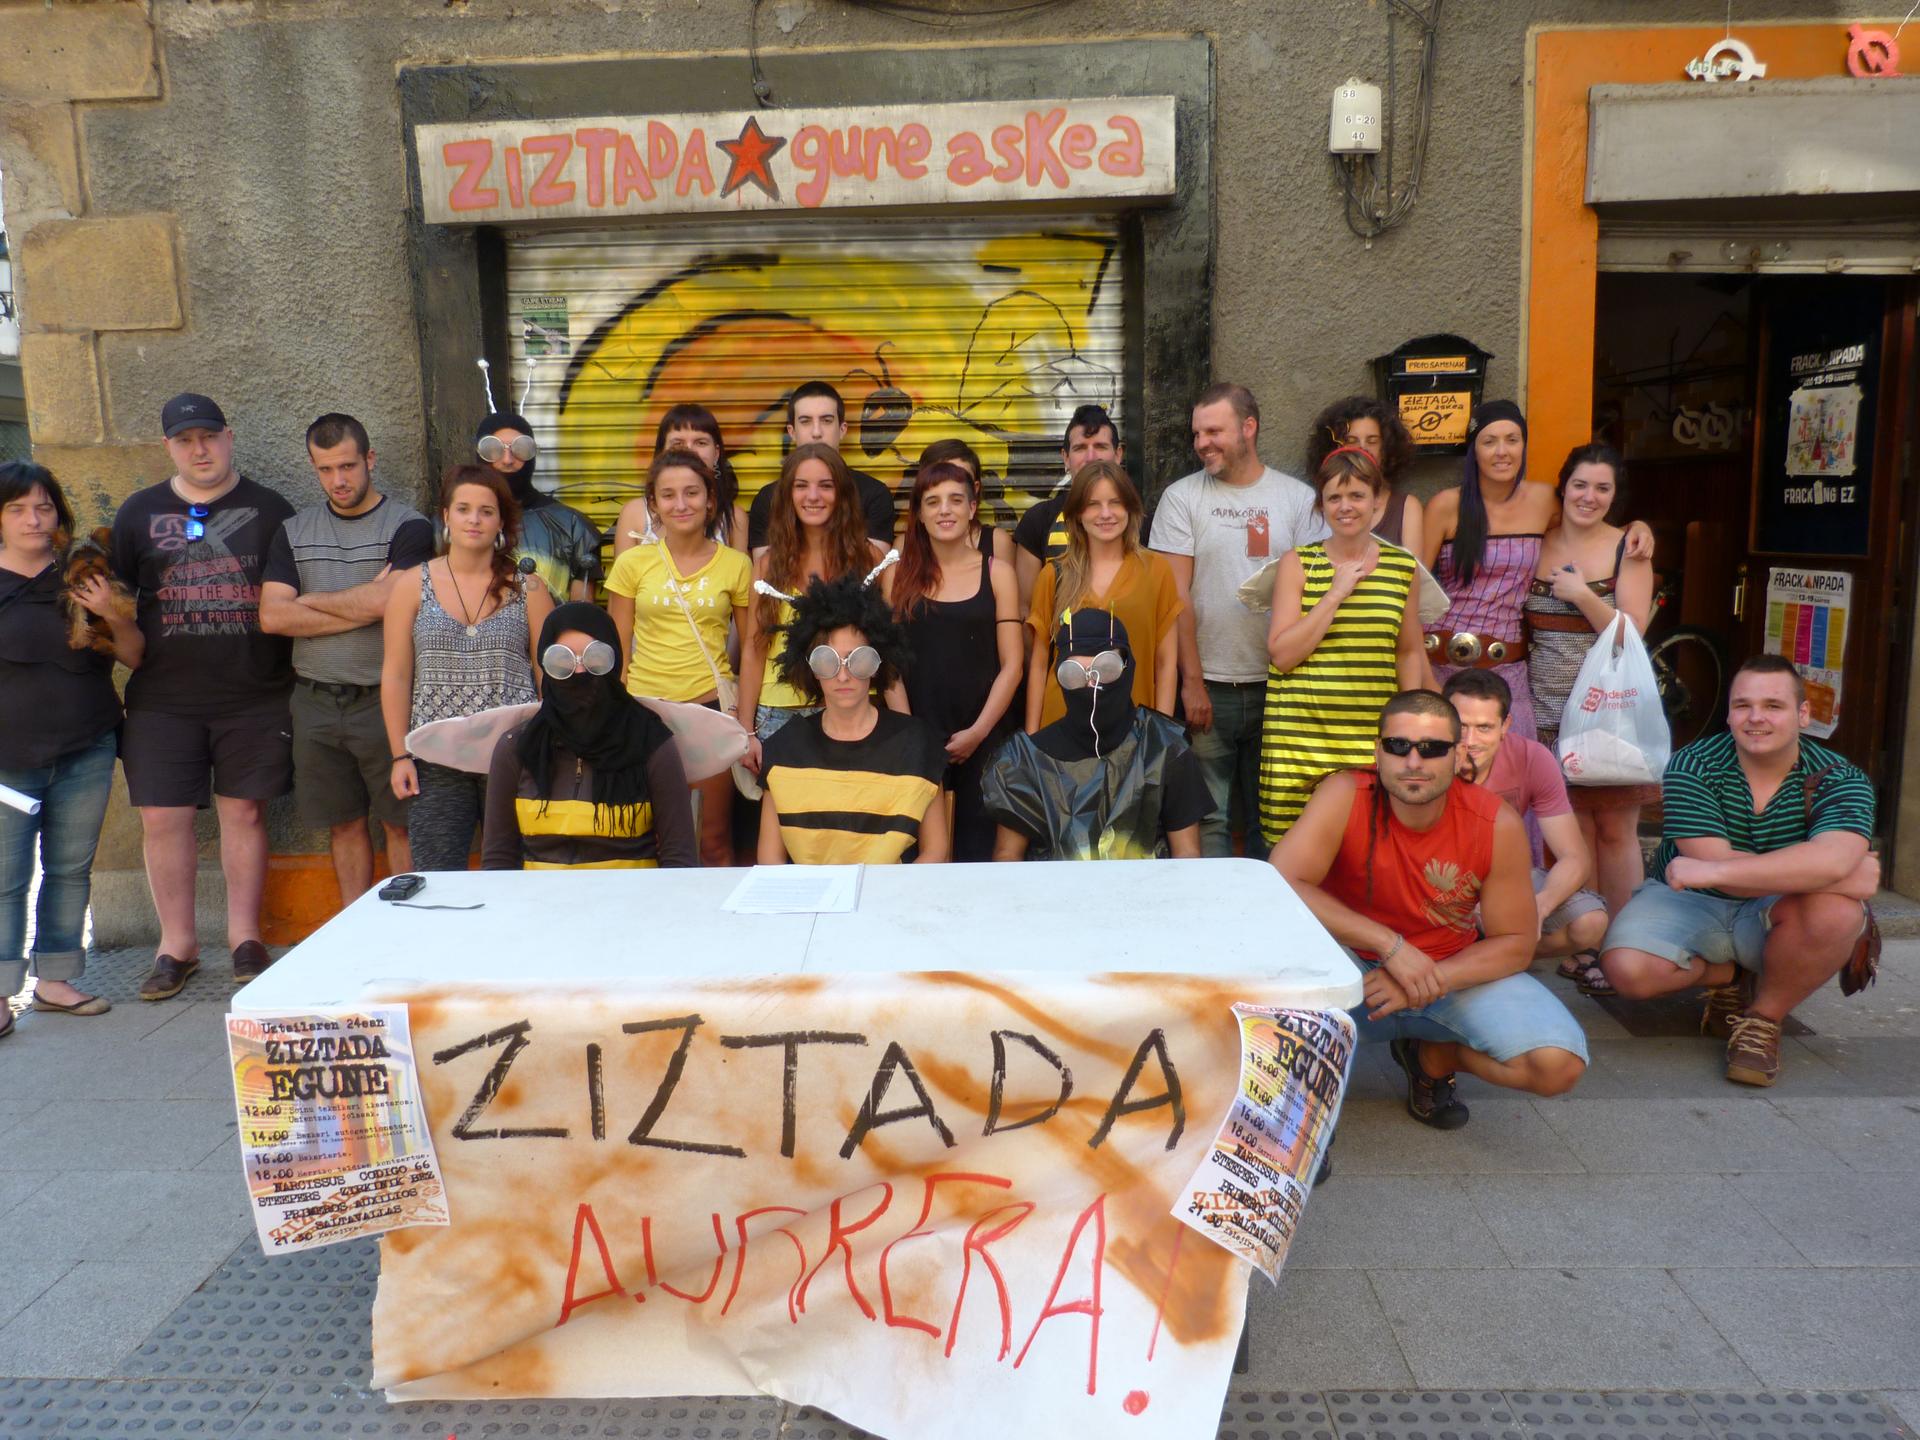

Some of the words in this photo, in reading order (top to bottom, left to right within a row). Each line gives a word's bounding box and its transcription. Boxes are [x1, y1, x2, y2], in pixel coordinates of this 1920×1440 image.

[1352, 131, 1365, 140] 40
[443, 120, 715, 212] ZIZTADA
[790, 122, 932, 209] gune
[199, 586, 223, 599] THE
[232, 585, 256, 599] SEA
[162, 613, 185, 624] WORK
[208, 610, 259, 623] PROGRESS
[346, 1017, 385, 1029] 24ean
[265, 1035, 391, 1065] ZIZTADA
[264, 1064, 389, 1101] EGUNE
[432, 1012, 1186, 1160] ZIZTADA
[245, 1104, 282, 1117] 12.00
[251, 1130, 289, 1143] 14.00
[255, 1152, 293, 1165] 16.00
[255, 1168, 294, 1181] 18.00
[1212, 1150, 1260, 1189] STEEPERS
[273, 1176, 346, 1193] NARCISSUS
[359, 1166, 408, 1182] CODIGO
[257, 1190, 321, 1207] STEEPERS
